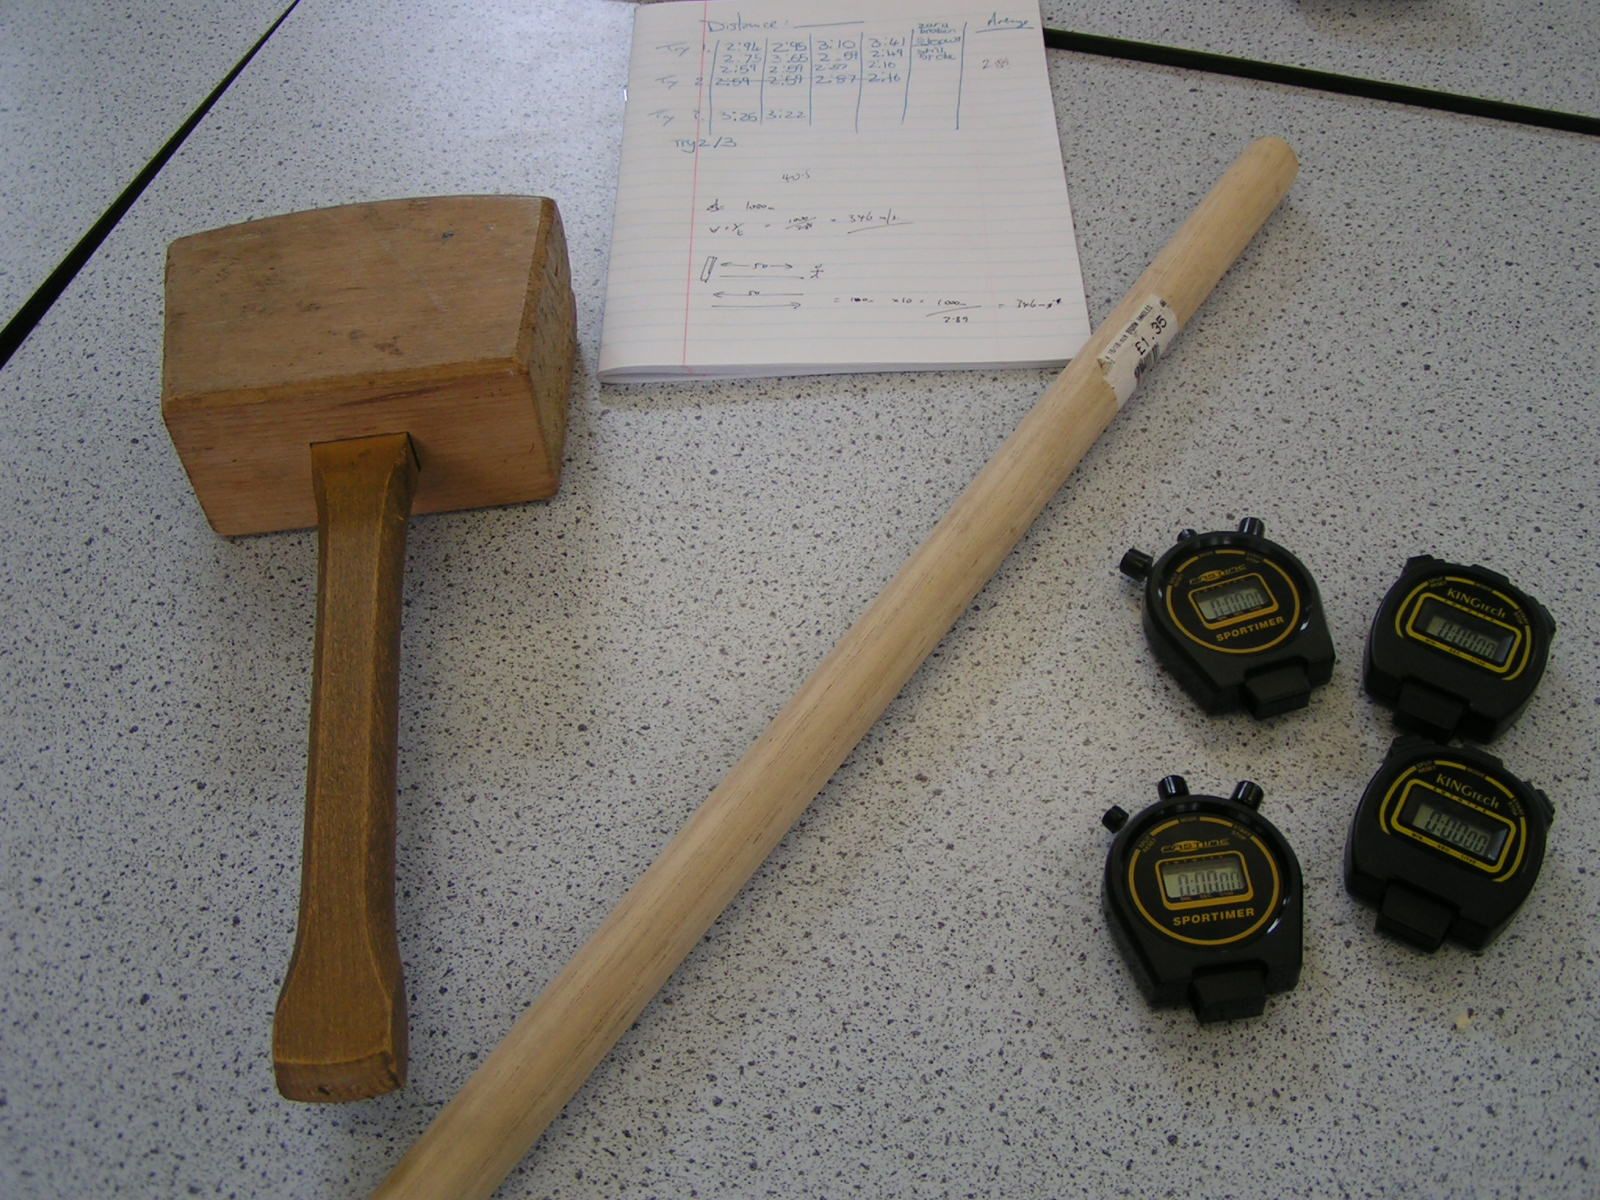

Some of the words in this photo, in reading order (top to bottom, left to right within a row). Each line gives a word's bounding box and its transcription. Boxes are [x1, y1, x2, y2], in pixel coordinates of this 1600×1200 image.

[1135, 315, 1168, 356] £1.35
[1215, 615, 1285, 642] SPORTIMER
[1172, 907, 1256, 927] SPORTIMER
